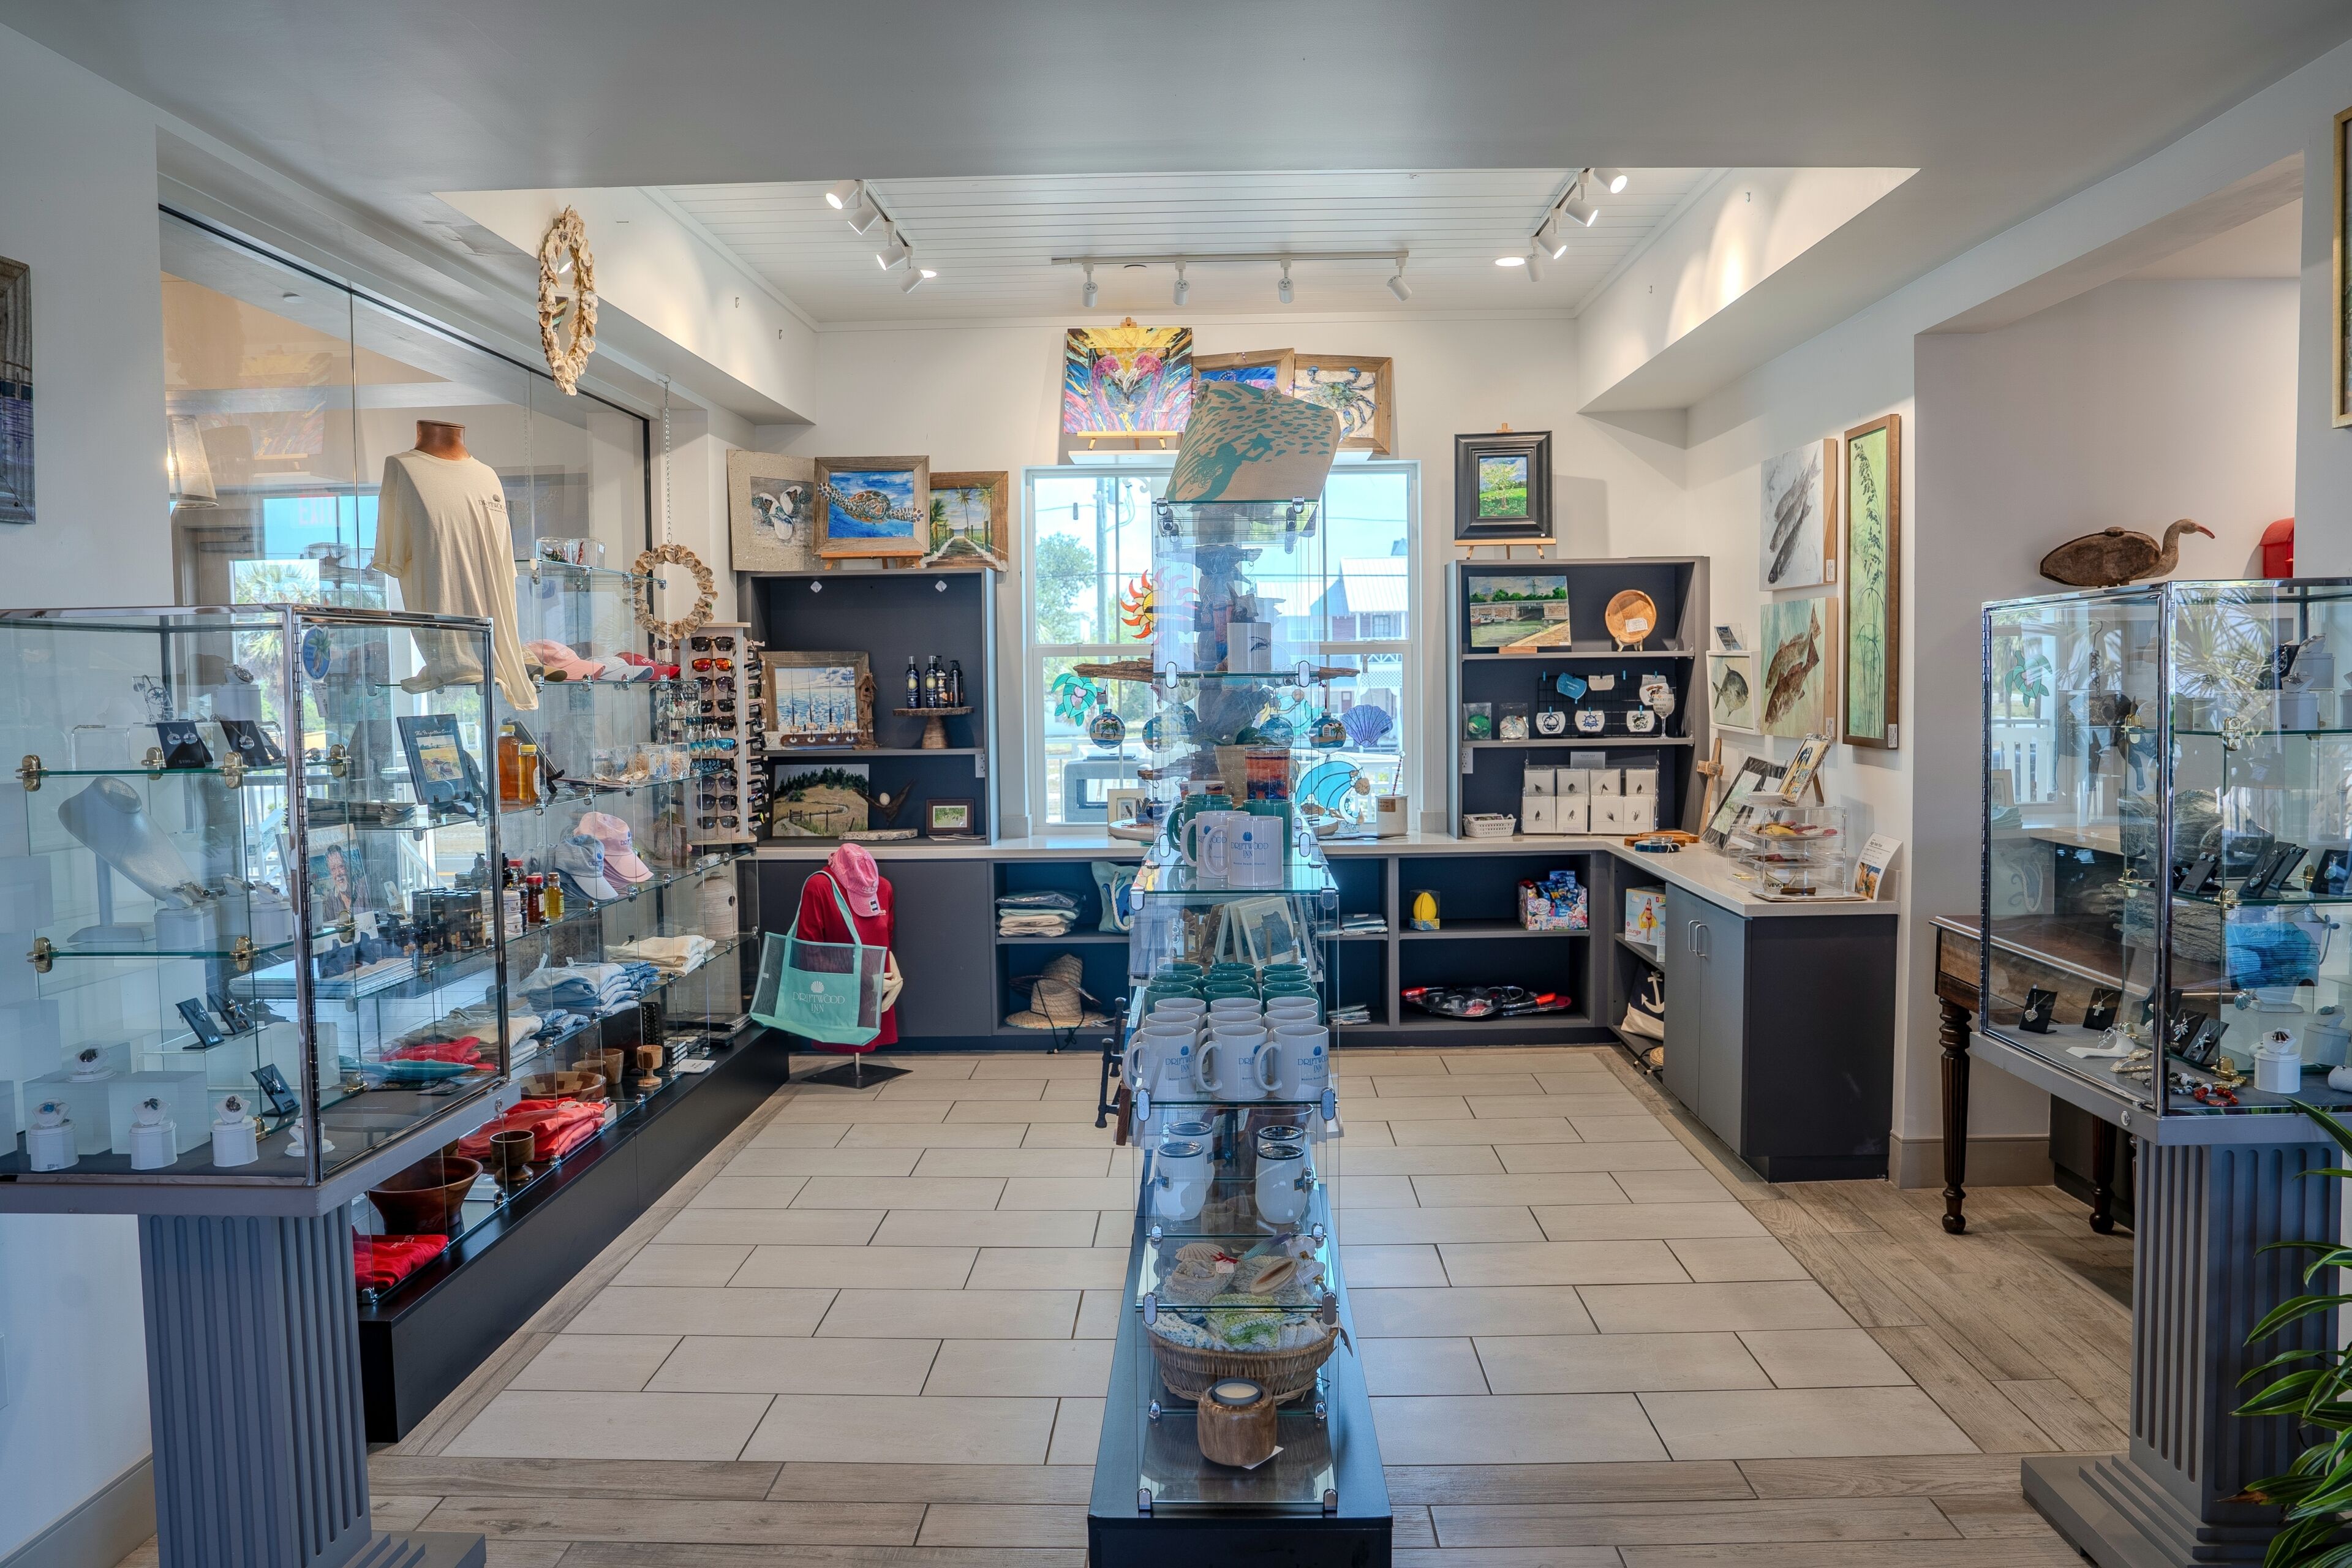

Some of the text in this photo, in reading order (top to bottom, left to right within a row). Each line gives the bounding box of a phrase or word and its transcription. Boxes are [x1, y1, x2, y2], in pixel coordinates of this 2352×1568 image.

[1231, 841, 1269, 851] DRIFTWOOD
[1243, 850, 1253, 859] INN
[2242, 927, 2299, 938] Larimar
[793, 992, 845, 1004] DRIFTWOOD
[811, 1003, 824, 1014] INN
[1313, 1064, 1322, 1073] INN
